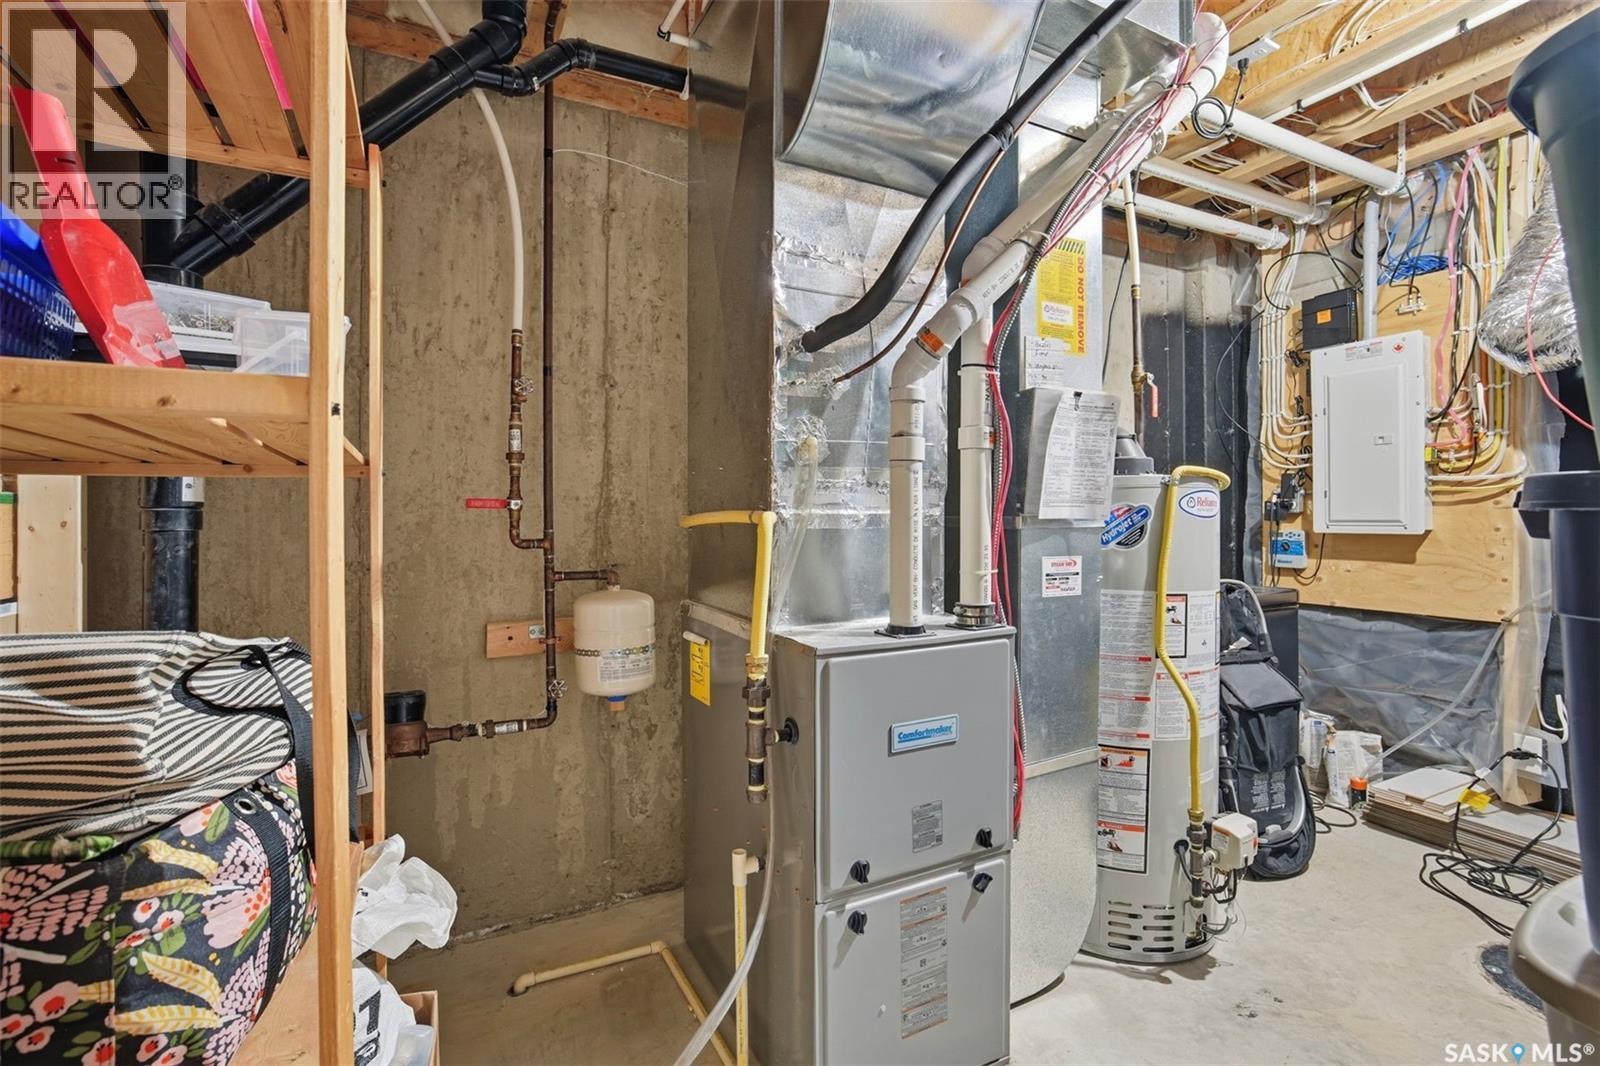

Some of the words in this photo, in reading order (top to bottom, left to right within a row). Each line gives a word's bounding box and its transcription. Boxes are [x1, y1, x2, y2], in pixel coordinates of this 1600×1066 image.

[1077, 256, 1084, 273] DO
[1077, 277, 1085, 302] NOT
[1077, 304, 1085, 353] REMOVE
[897, 725, 953, 740] Comfortmaker
